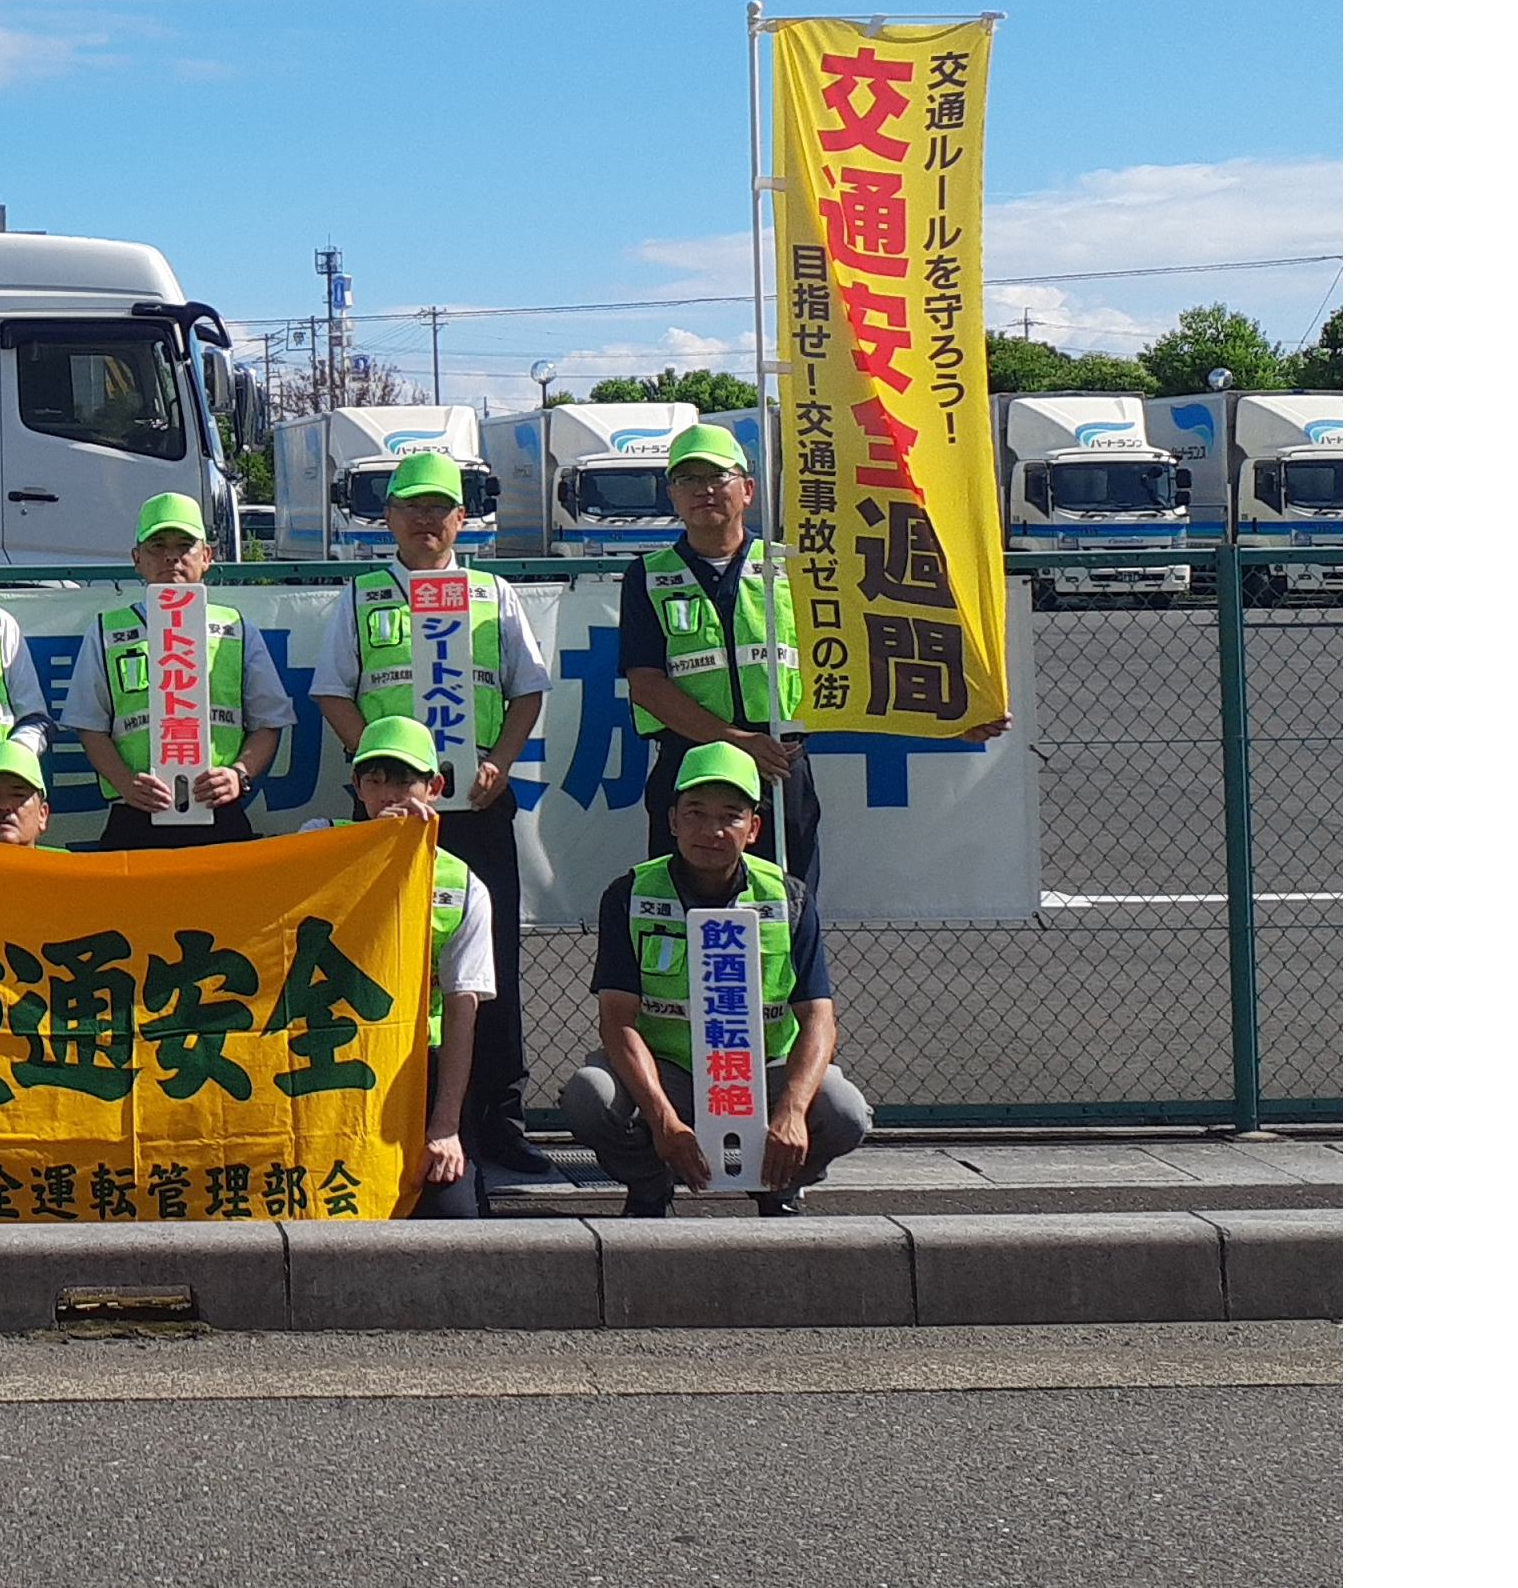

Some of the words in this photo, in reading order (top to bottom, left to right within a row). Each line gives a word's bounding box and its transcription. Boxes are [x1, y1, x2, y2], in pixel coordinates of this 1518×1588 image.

[816, 47, 970, 722] 交通安全週間
[624, 444, 670, 454] ハートラン
[654, 573, 683, 587] 交通
[366, 588, 393, 602] 交通
[414, 583, 467, 609] 全席
[112, 630, 139, 644] 交通
[208, 623, 236, 637] 安全
[156, 587, 202, 766] シートベルト着用
[421, 616, 466, 753] シートベルト
[472, 669, 495, 685] TROL
[210, 708, 236, 725] TROL
[639, 900, 673, 917] 交通
[699, 918, 755, 1118] 飲酒運転根絶
